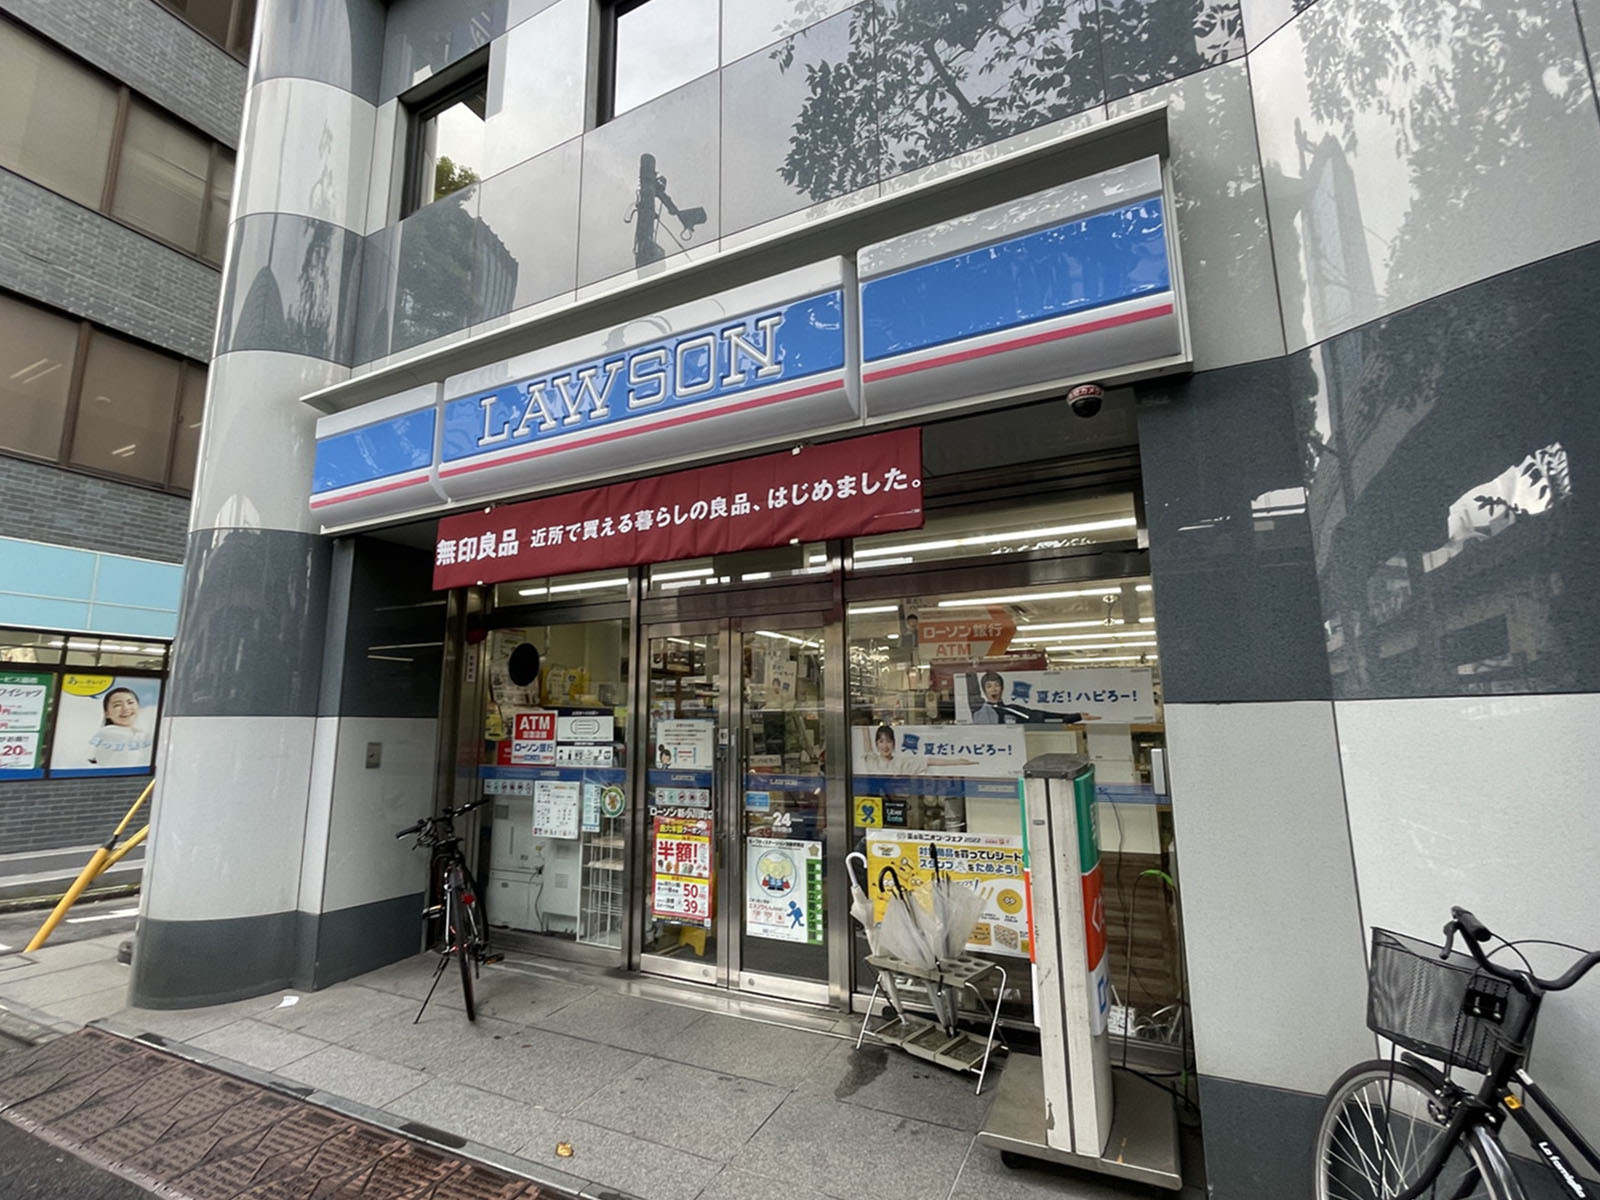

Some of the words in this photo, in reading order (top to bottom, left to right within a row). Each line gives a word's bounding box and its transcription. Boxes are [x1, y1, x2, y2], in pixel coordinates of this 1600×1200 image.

[477, 312, 783, 447] LAWSON
[435, 527, 520, 567] 無印良品
[531, 467, 922, 548] 近所で買える暮らしの良品、はじめました。
[923, 624, 1002, 639] ローソン銀行
[936, 643, 972, 656] ATM
[519, 716, 550, 730] ATM
[772, 812, 792, 827] 24
[658, 841, 698, 864] 半額!
[683, 883, 699, 899] 50
[683, 899, 699, 914] 39
